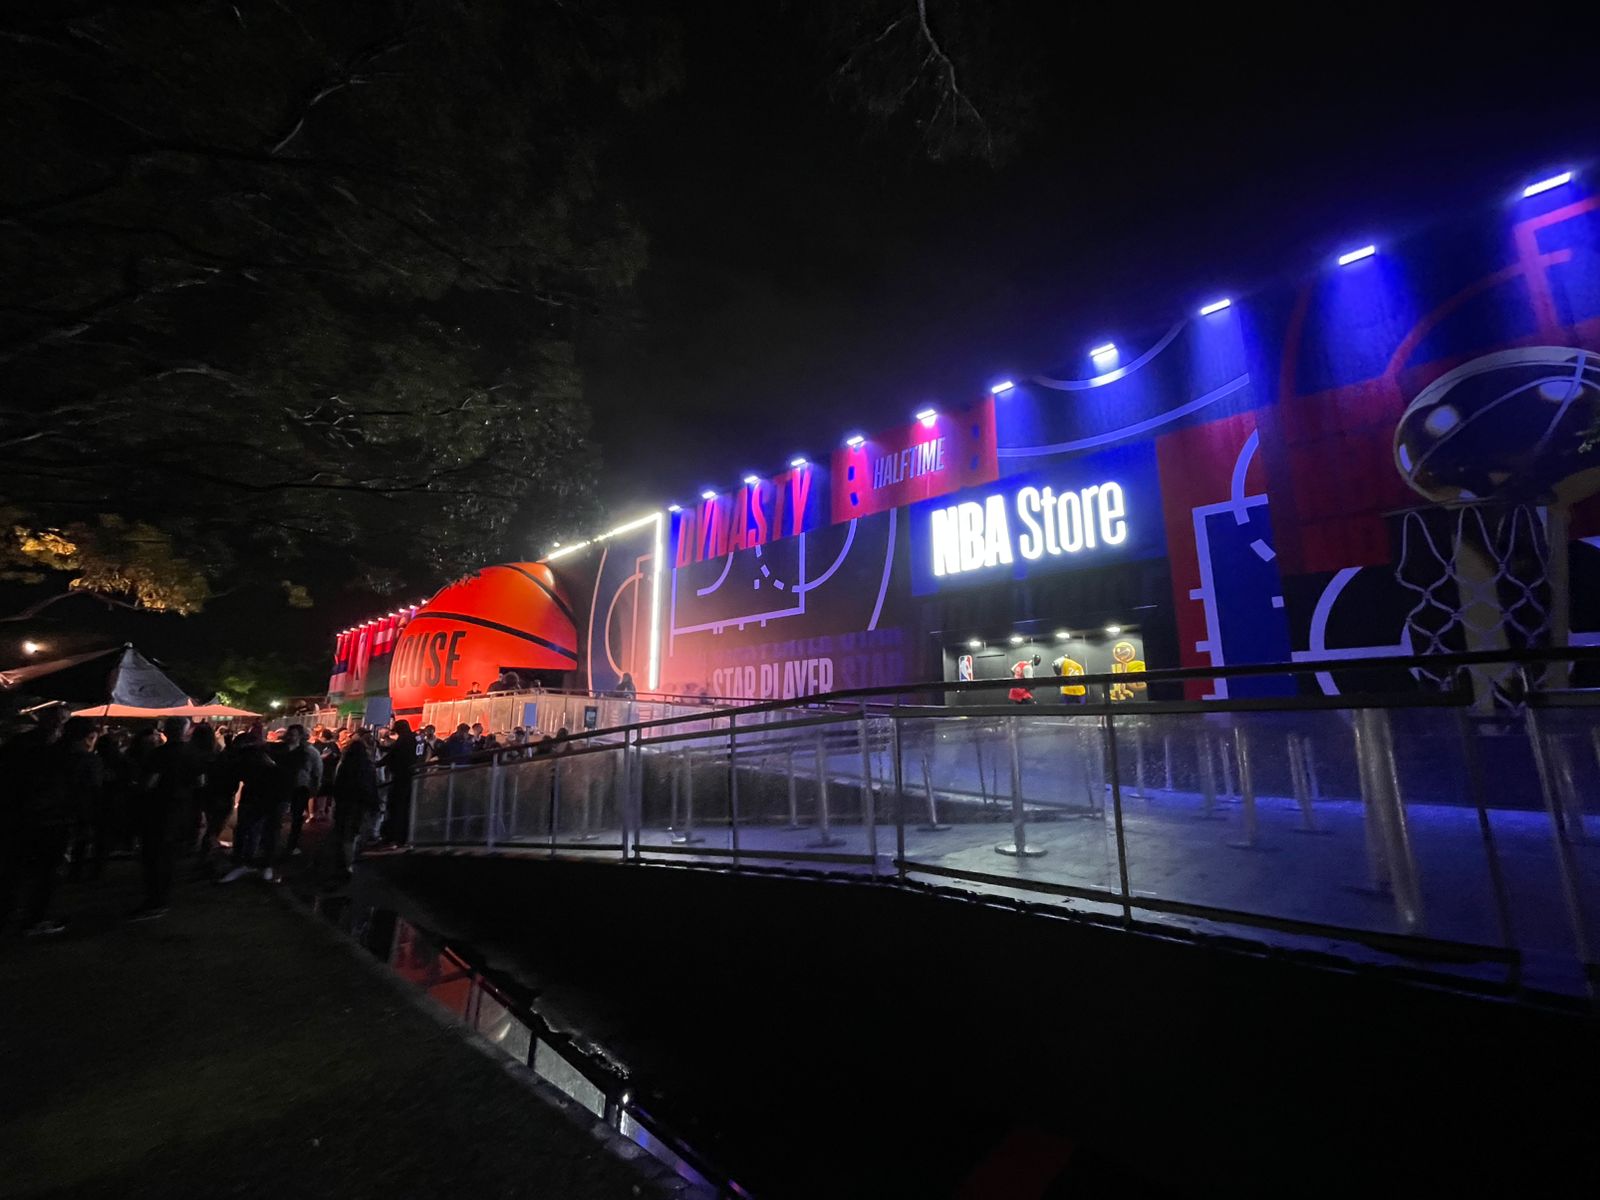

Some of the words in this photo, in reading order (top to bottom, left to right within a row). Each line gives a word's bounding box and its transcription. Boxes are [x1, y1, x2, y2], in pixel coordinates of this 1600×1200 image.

[874, 438, 945, 489] HALFTIME
[676, 465, 812, 568] DYNASTY
[931, 494, 1013, 577] NBA
[1017, 481, 1127, 560] Store
[712, 665, 756, 705] STAR
[760, 657, 834, 700] PLAYER
